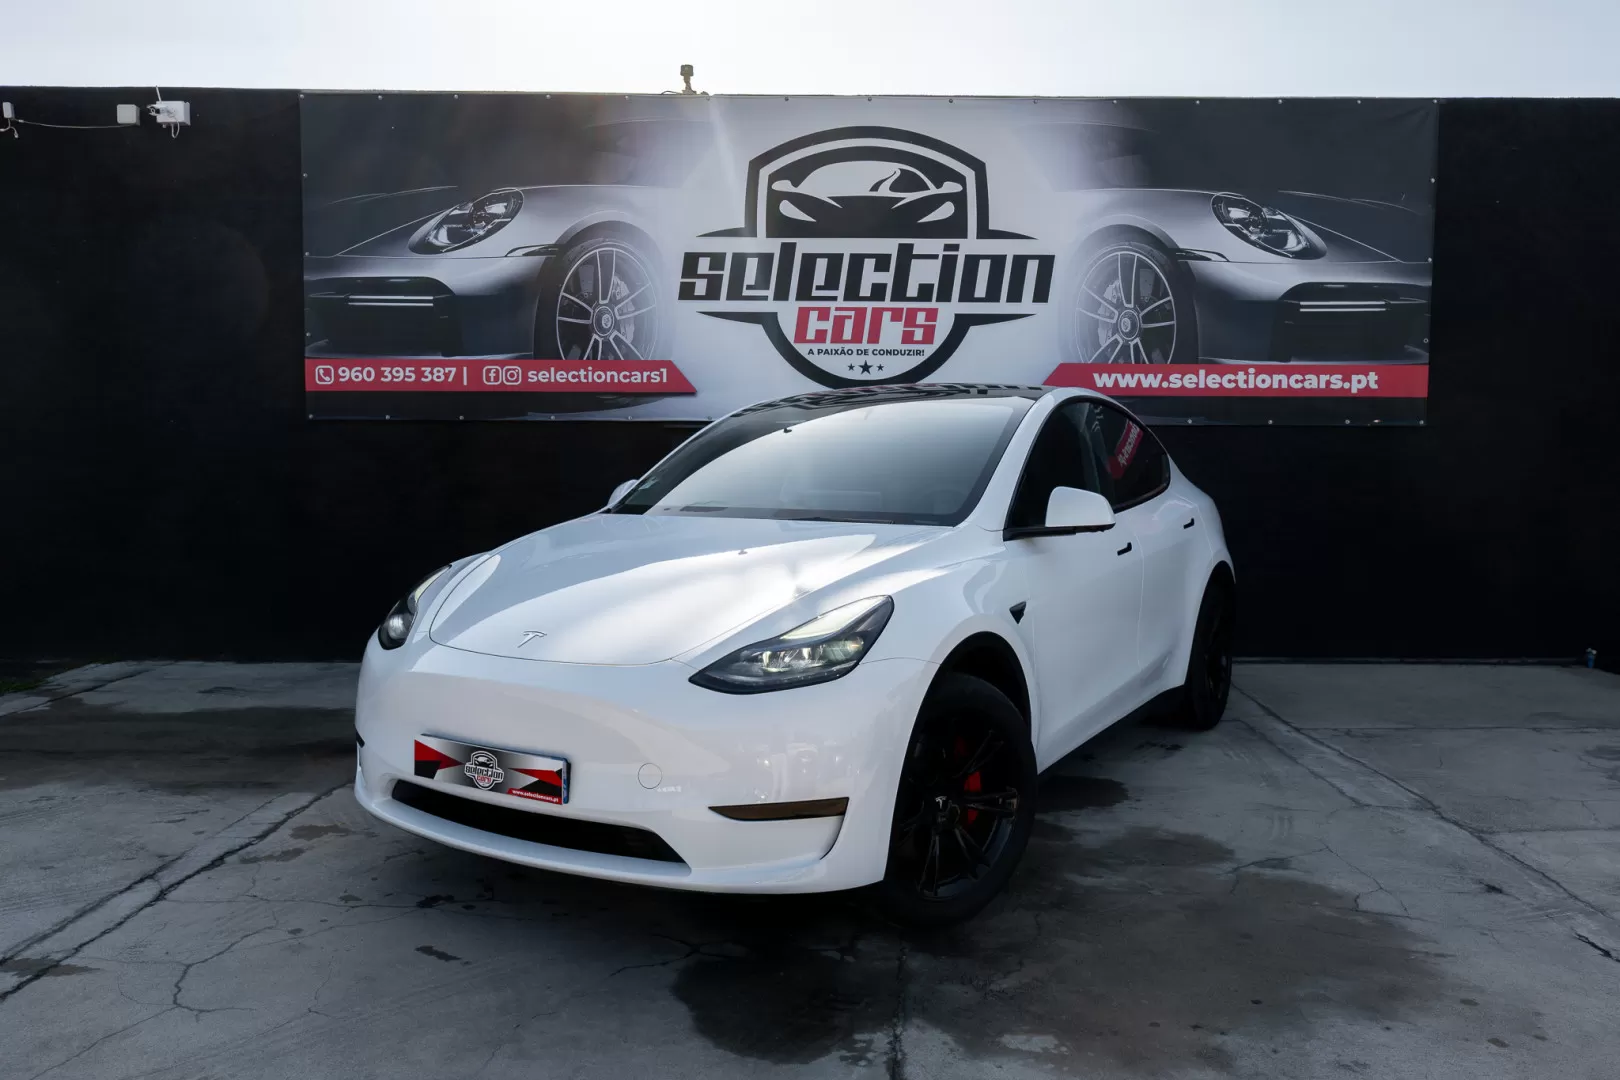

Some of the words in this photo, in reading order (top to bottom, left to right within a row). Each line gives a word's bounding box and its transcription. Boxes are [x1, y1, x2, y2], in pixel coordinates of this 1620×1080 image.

[678, 242, 1055, 303] selection
[793, 306, 939, 345] cars
[807, 348, 814, 356] A
[817, 347, 854, 356] PAIXÃO
[856, 348, 869, 356] DE
[872, 348, 925, 357] CONDUZIR!
[338, 366, 375, 382] 960
[380, 366, 416, 382] 395
[421, 366, 456, 382] 387
[527, 366, 668, 384] selectioncars1
[1093, 367, 1379, 393] www.selectioncars.pt
